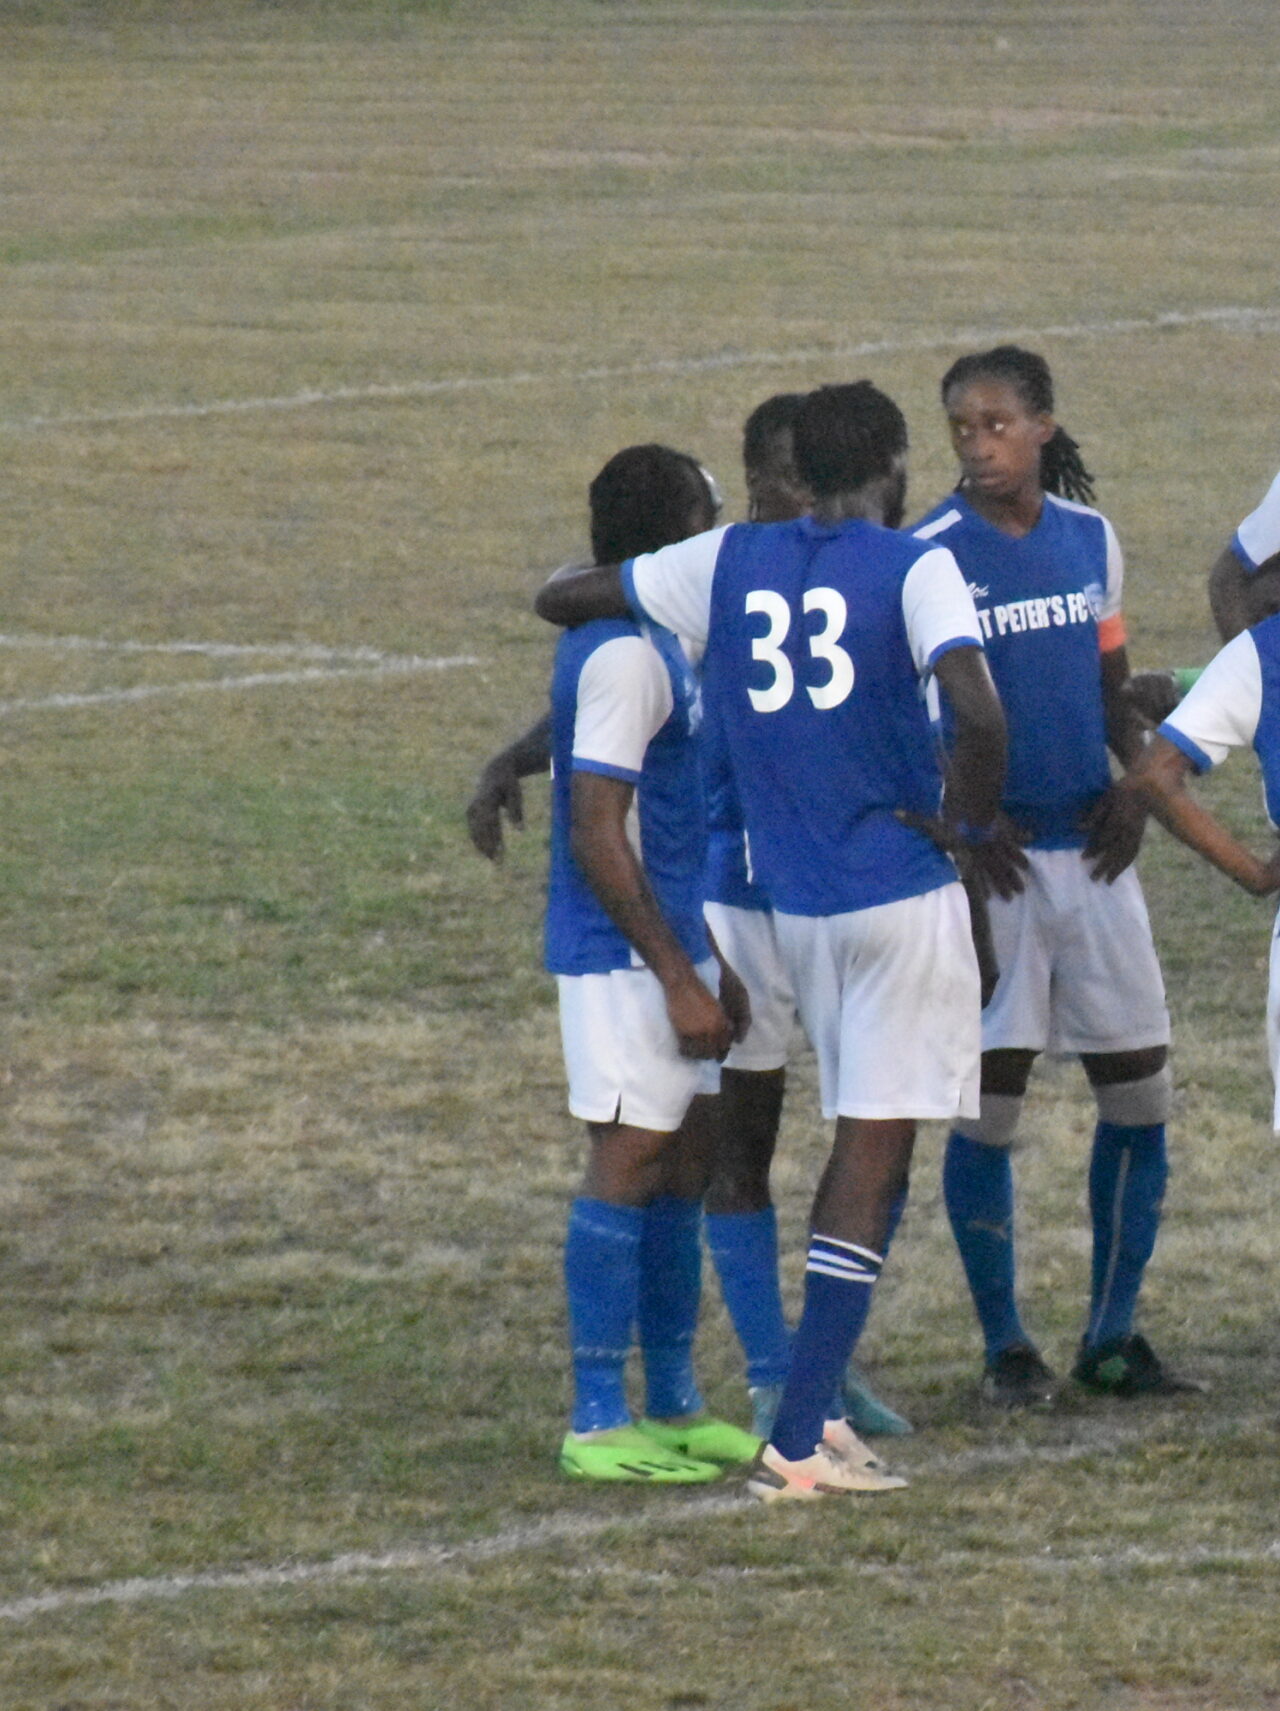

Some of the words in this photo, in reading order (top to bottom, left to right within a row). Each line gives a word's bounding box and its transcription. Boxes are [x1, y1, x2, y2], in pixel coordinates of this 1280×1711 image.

[744, 586, 854, 713] 33
[994, 595, 1066, 636] PETER'S
[1066, 591, 1089, 624] FC
